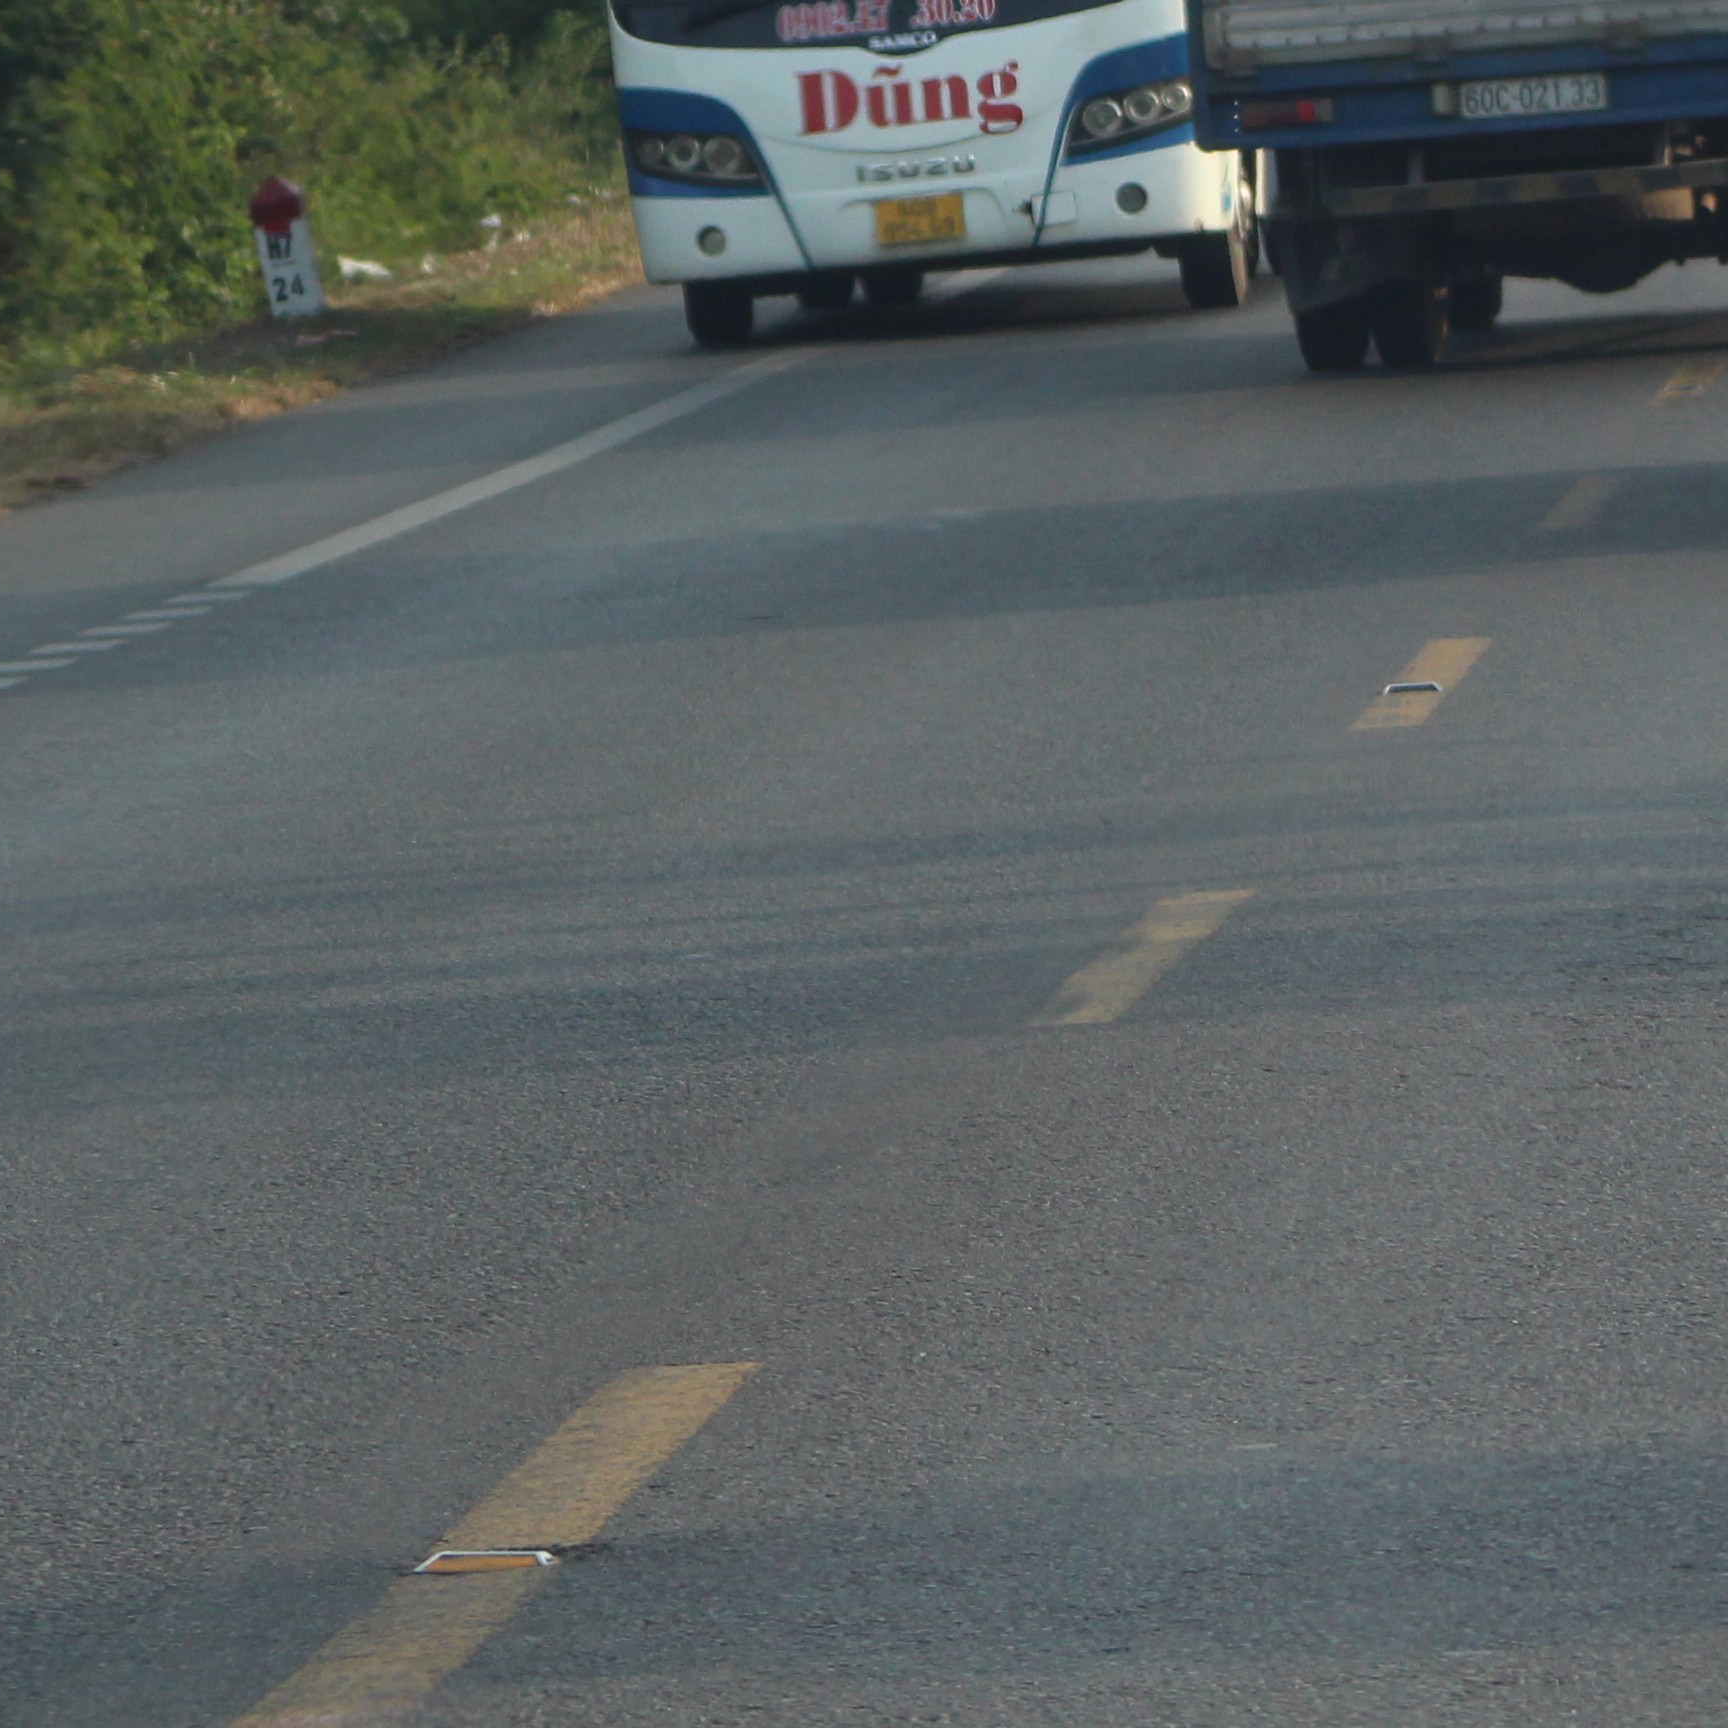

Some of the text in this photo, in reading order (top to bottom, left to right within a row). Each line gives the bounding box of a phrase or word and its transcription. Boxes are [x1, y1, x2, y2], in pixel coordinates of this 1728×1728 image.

[868, 30, 937, 52] SAMCO
[795, 59, 1024, 135] Dũng
[855, 153, 976, 183] ISUZU
[271, 273, 305, 303] 24
